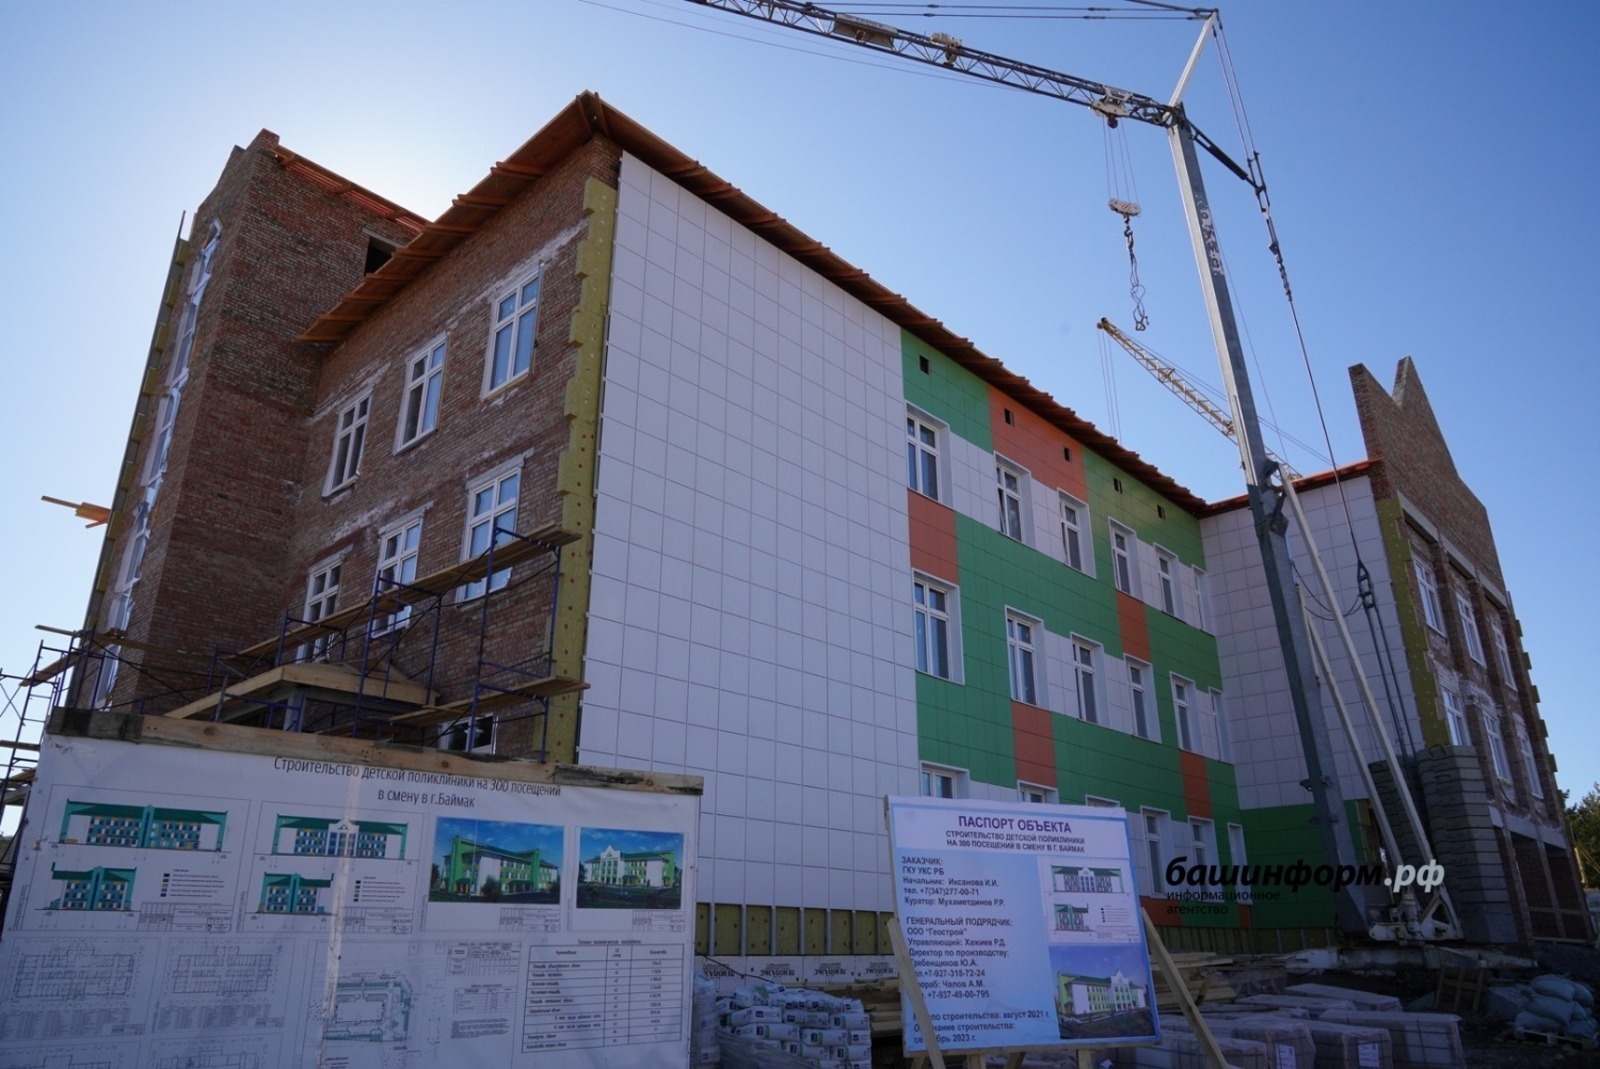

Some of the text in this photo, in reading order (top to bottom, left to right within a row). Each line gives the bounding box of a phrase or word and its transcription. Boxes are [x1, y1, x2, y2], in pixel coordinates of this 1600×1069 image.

[274, 756, 561, 797] Строительство детской поликлиники на 300 посещений
[378, 790, 475, 808] в смену в г.Баймак
[958, 816, 1072, 833] ПАСПОРТ ОБЪЕКТА
[946, 830, 1085, 844] СТРОИТЕЛЬСТВО ДЕТСКОЙ ПОЛИКЛИНИКИ
[972, 840, 1015, 850] ПОСЕЩЕНИЙ
[1059, 844, 1085, 852] БАЙМАК
[901, 856, 943, 865] ЗАКАЗЧИК:
[902, 866, 916, 874] ГКУ
[903, 877, 944, 886] Начальник:
[948, 878, 984, 886] Иксанова
[920, 887, 979, 896] +7(347)277-00-71
[904, 896, 936, 906] Куратор:
[938, 898, 992, 907] Мухаметдинов
[906, 916, 1012, 927] ГЕНЕРАЛЬНЫЙ ПОДРЯДЧИК:
[908, 938, 963, 947] Управляющий:
[909, 949, 943, 957] Директор
[956, 950, 1009, 958] производству:
[942, 1013, 1001, 1022] строительства:
[1003, 1013, 1026, 1021] август
[957, 1022, 1015, 1031] строительства:
[952, 1034, 970, 1042] 2023
